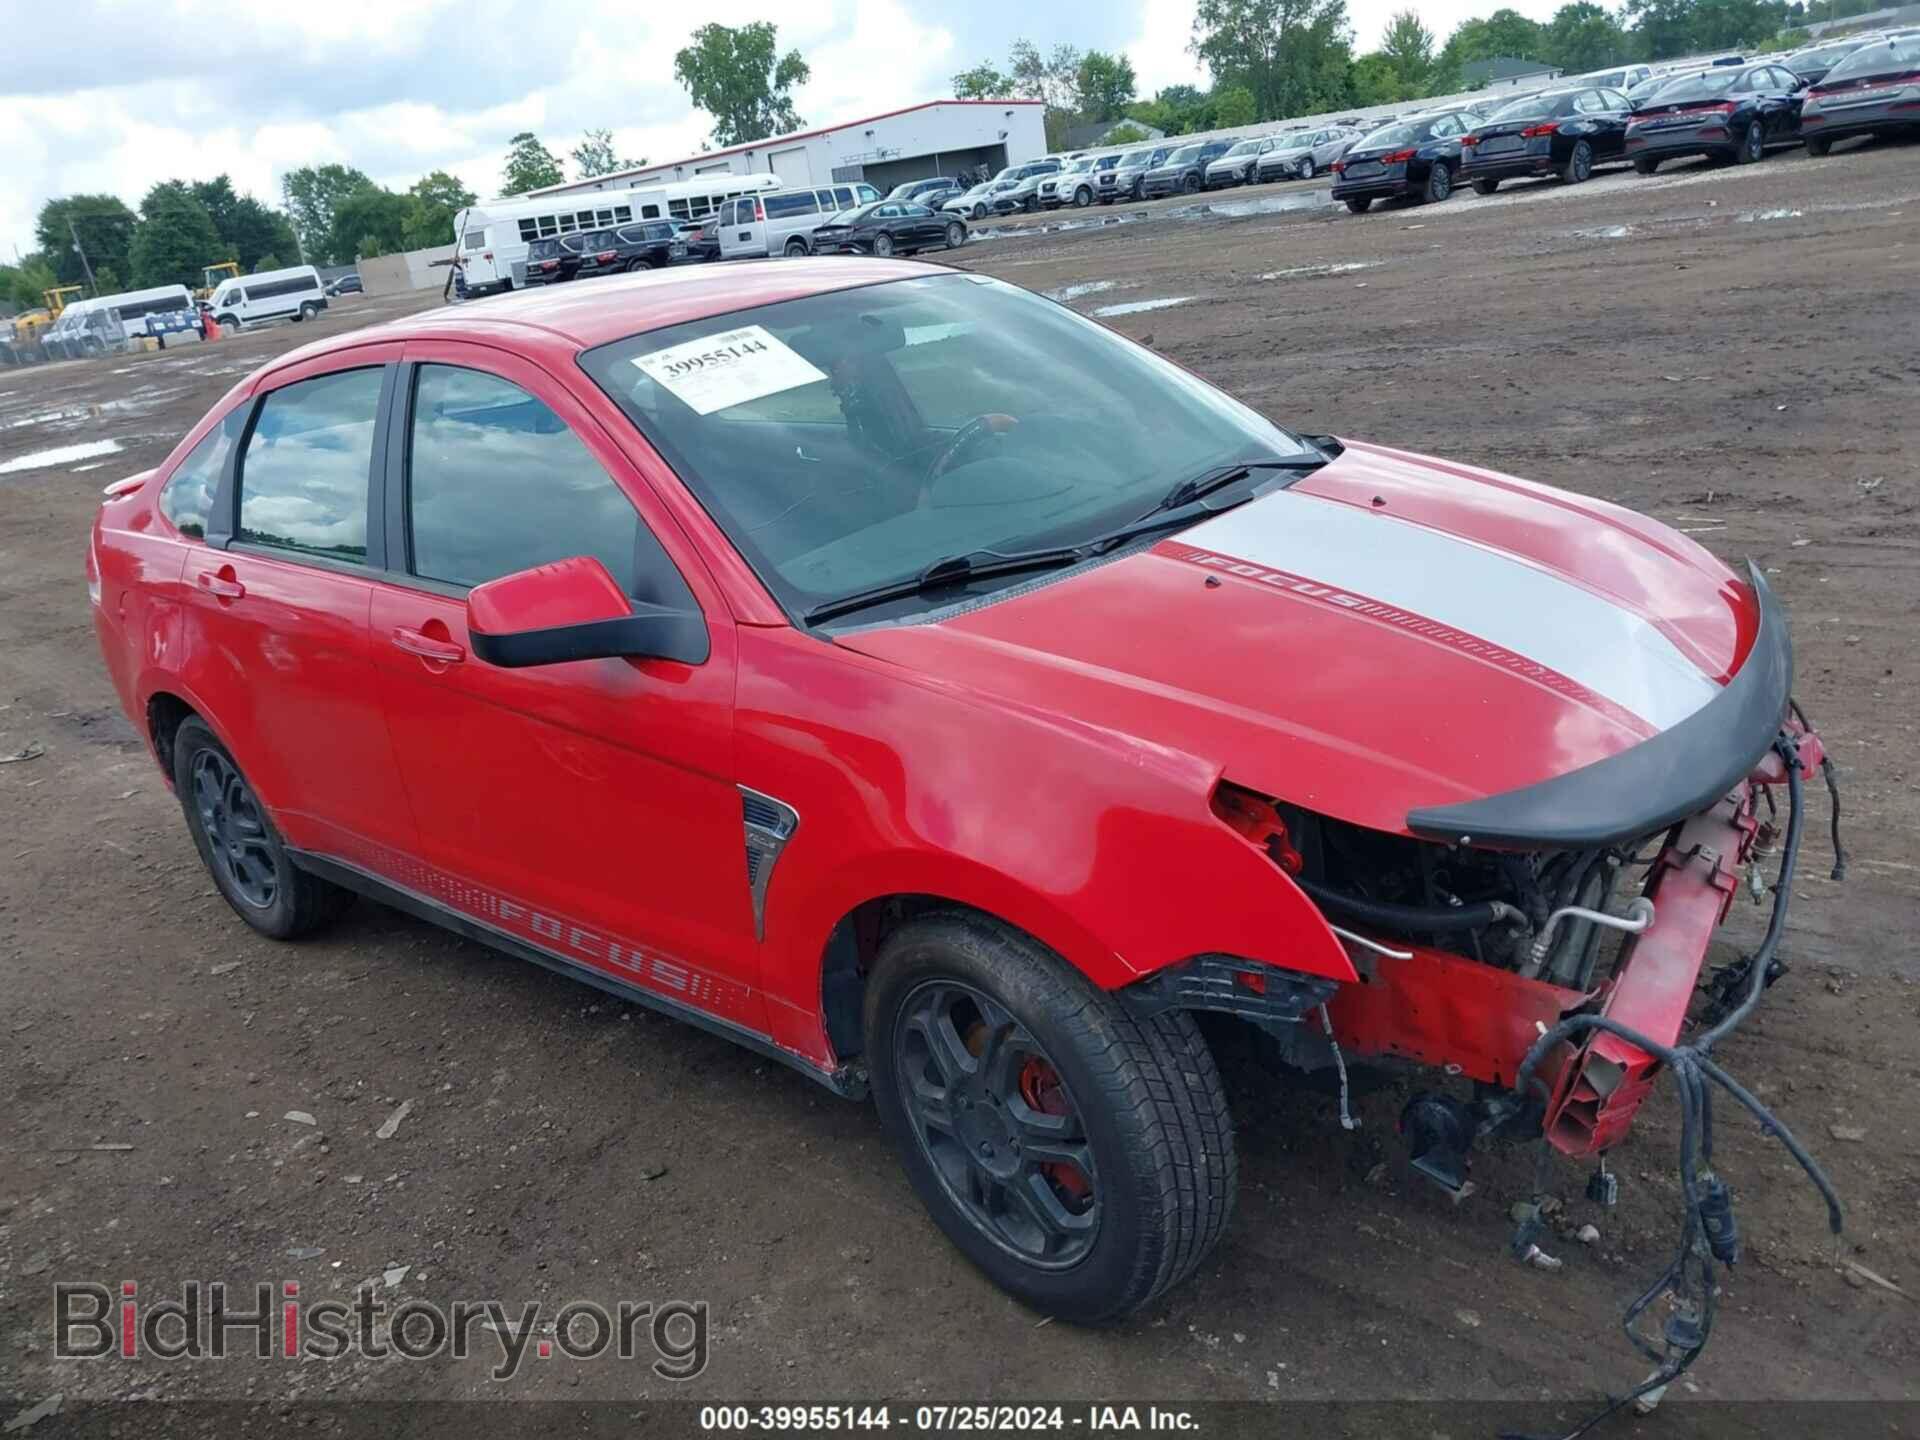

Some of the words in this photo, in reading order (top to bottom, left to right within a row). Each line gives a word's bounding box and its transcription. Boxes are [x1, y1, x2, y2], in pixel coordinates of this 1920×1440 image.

[662, 340, 768, 378] 39955144
[1197, 556, 1366, 608] FOCUS
[499, 899, 690, 991] FOCUS
